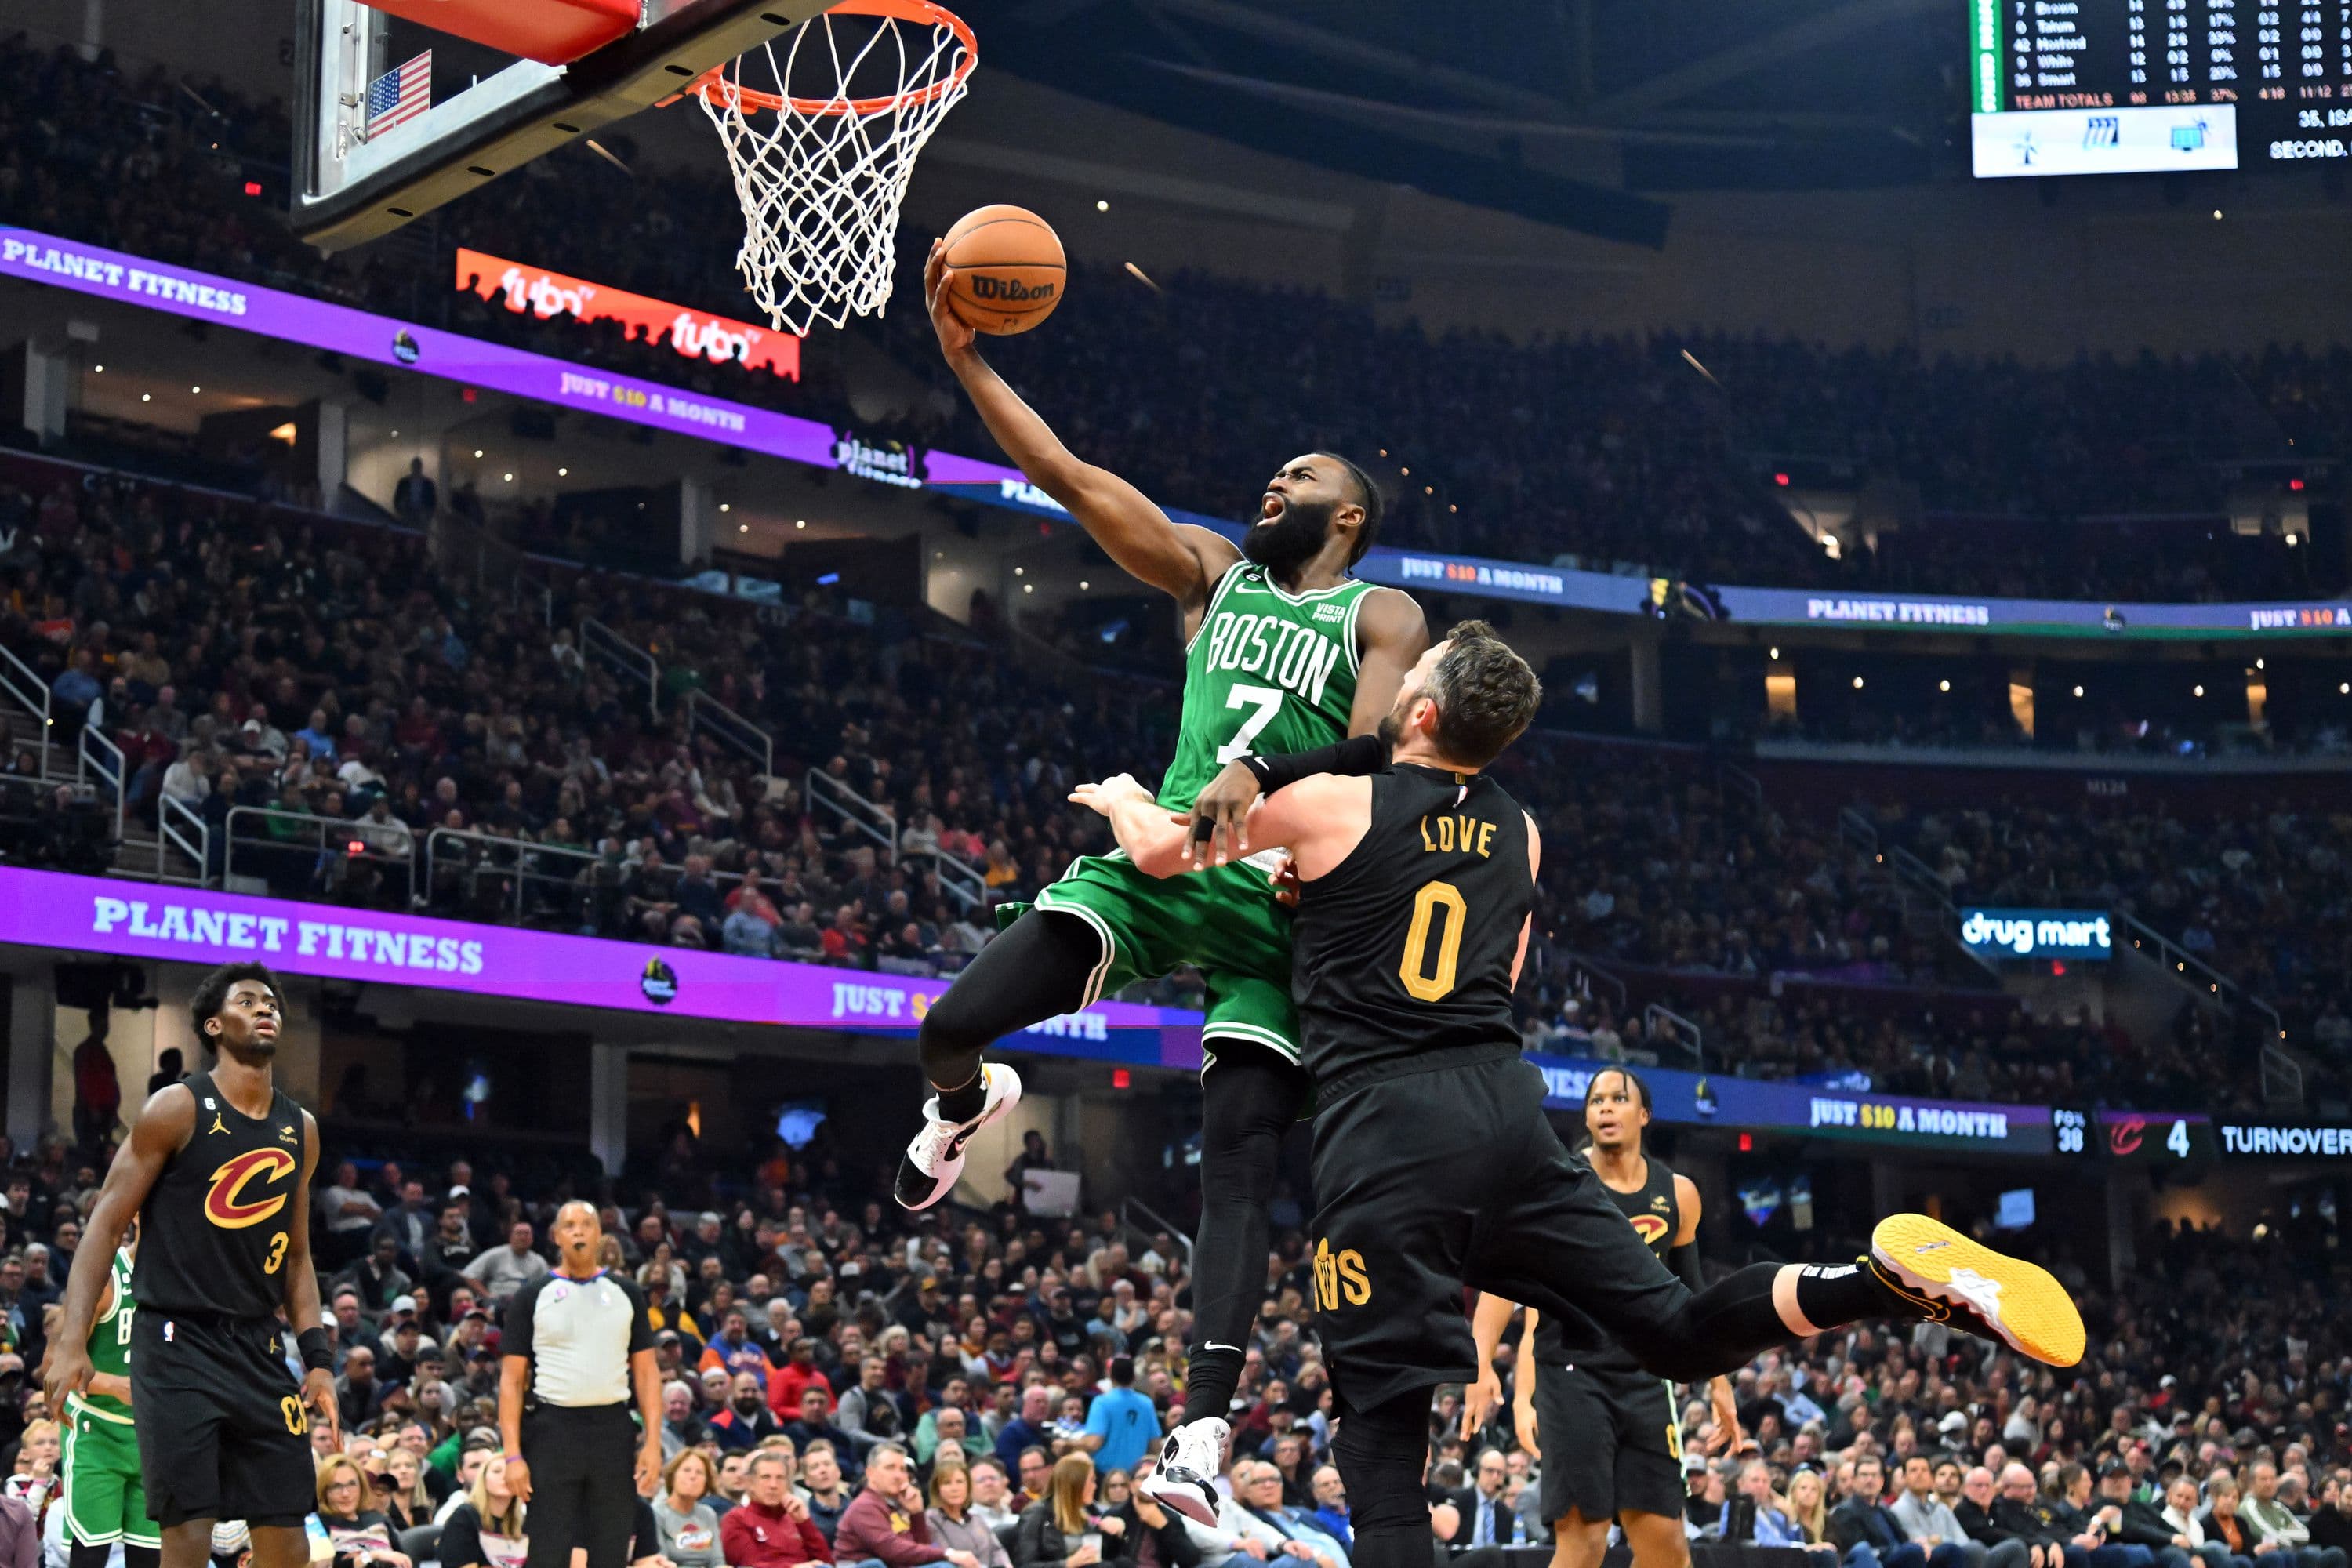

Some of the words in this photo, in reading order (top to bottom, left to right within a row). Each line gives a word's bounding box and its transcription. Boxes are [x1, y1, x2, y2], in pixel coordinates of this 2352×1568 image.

[2015, 94, 2056, 109] TEAM
[2058, 92, 2114, 108] TOTALS
[3, 239, 123, 285] PLANET
[128, 269, 247, 315] FITNESS
[971, 275, 1054, 301] Wilson
[561, 372, 610, 399] JUST
[649, 394, 664, 413] A
[667, 397, 746, 432] MONTH
[1402, 557, 1444, 579] JUST
[1477, 568, 1492, 585] A
[1493, 569, 1563, 594] MONTH
[1312, 612, 1342, 624] PRINT
[1316, 602, 1346, 619] VISTA
[1807, 599, 1896, 622] PLANET
[1898, 602, 1989, 626] FITNESS
[2251, 610, 2297, 631] JUST
[1206, 612, 1341, 706] BOSTON
[1216, 683, 1284, 764] 7
[1421, 815, 1497, 858] LOVE
[93, 896, 289, 951] PLANET
[297, 921, 484, 975] FITNESS
[1399, 880, 1467, 1003] 0
[1962, 912, 2034, 953] drug
[2038, 917, 2111, 947] mart
[832, 982, 906, 1018] JUST
[1810, 1097, 1857, 1127] JUST
[1897, 1106, 1915, 1131] A
[1918, 1108, 2007, 1138] MONTH
[2167, 1119, 2190, 1158] 4
[263, 1232, 289, 1275] 3
